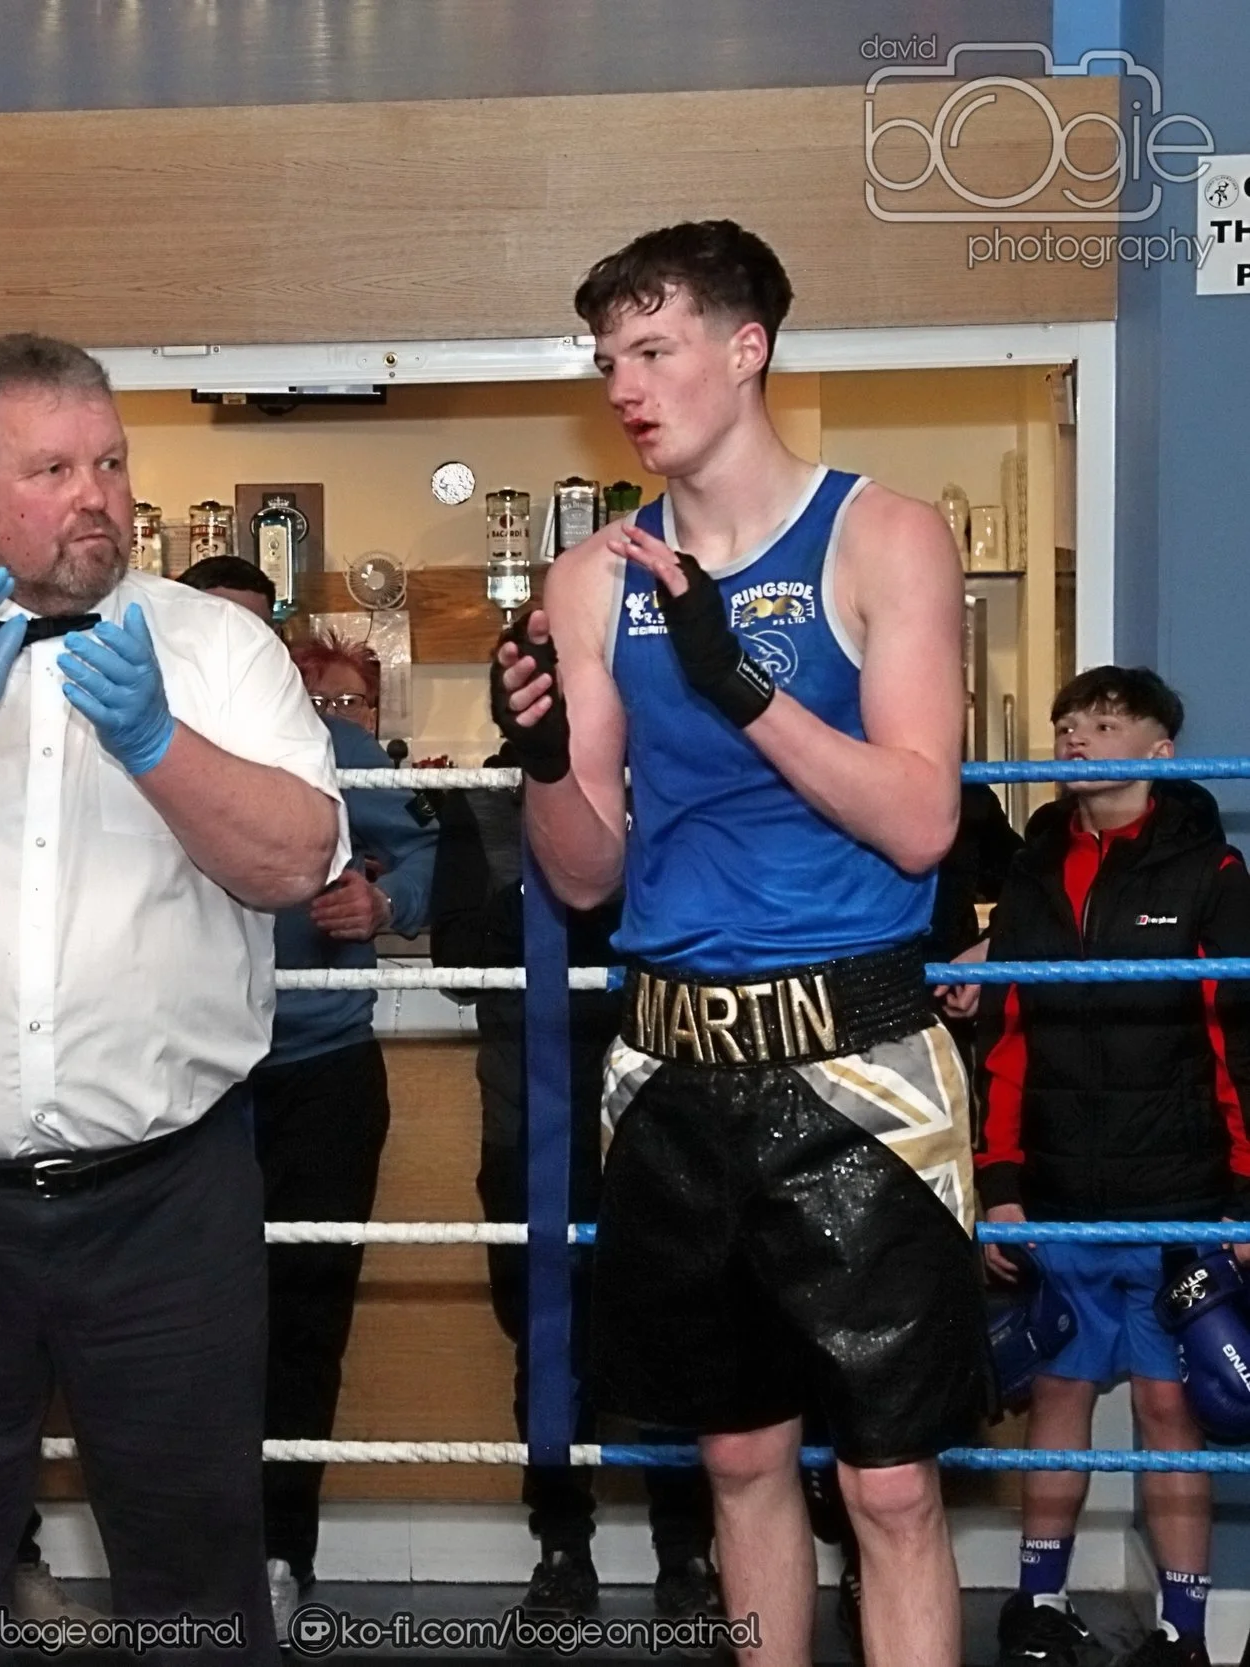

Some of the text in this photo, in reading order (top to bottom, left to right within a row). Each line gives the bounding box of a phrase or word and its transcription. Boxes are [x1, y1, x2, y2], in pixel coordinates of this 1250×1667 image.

[731, 581, 814, 609] RINGSIDE
[637, 973, 836, 1063] MARTIN
[1026, 1539, 1061, 1550] WONG
[1166, 1571, 1195, 1584] SUZI
